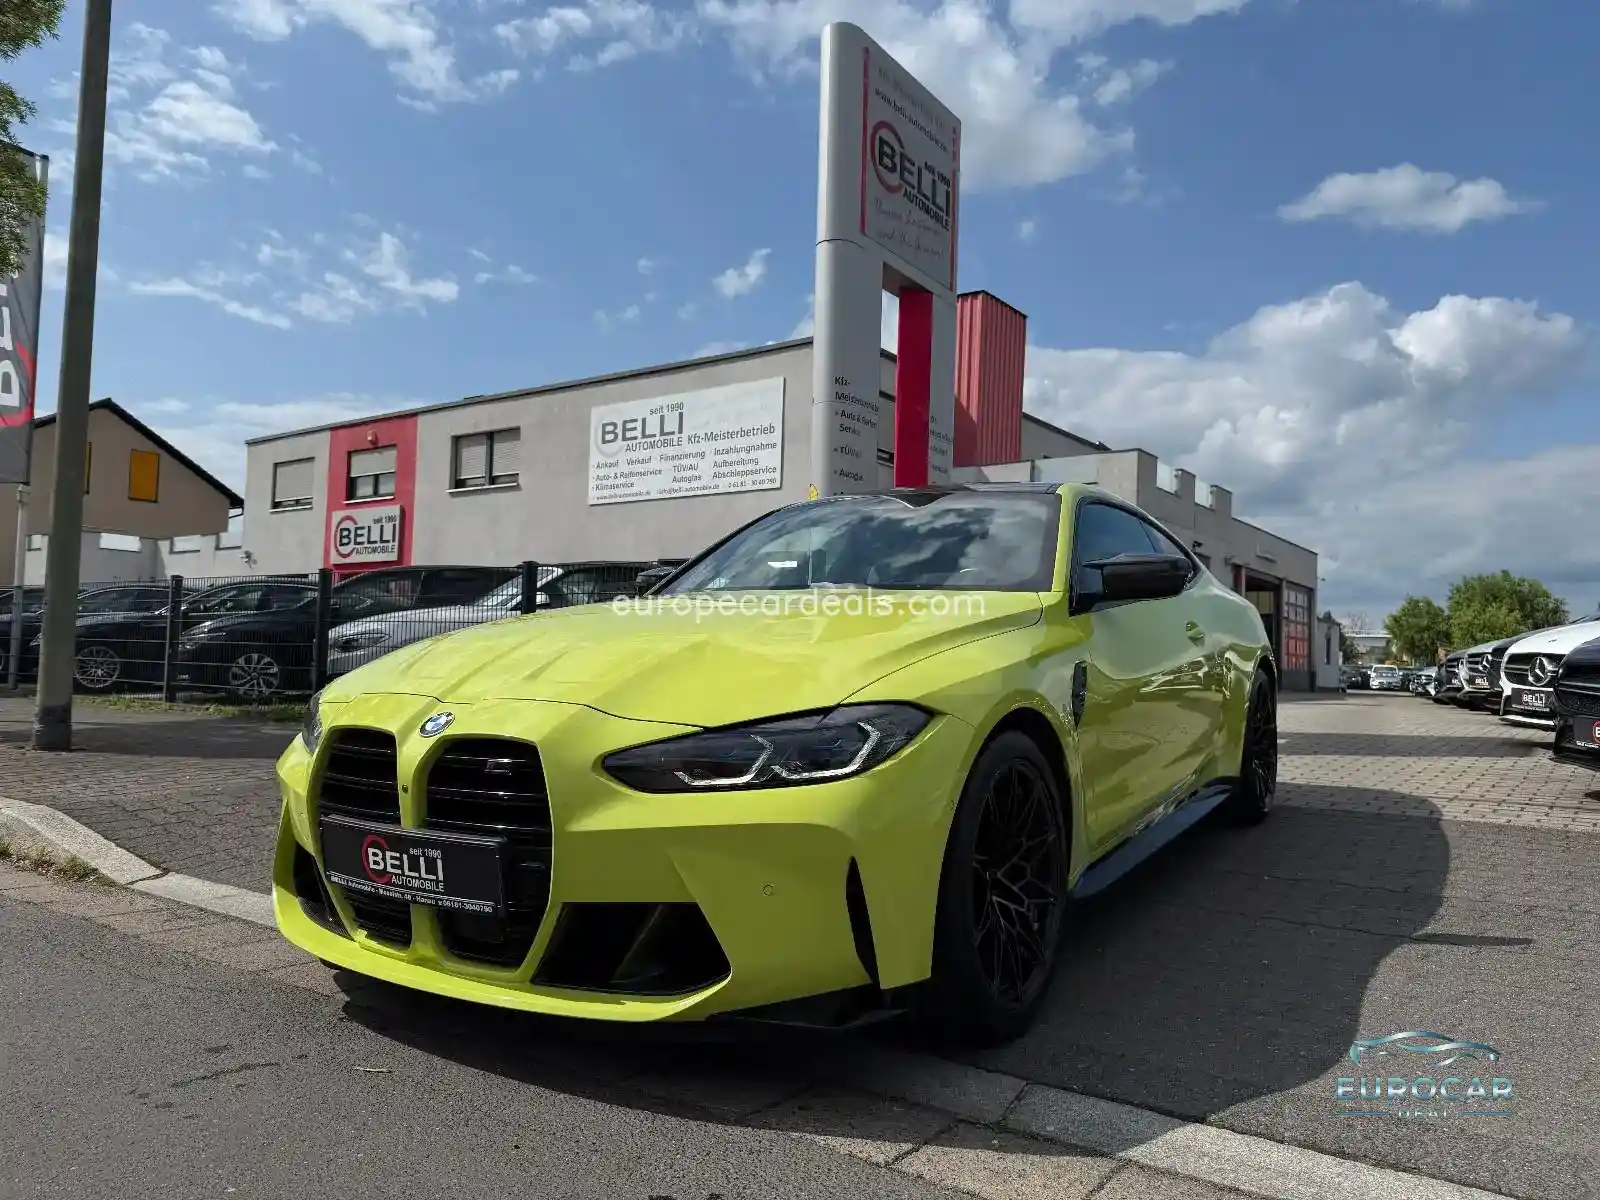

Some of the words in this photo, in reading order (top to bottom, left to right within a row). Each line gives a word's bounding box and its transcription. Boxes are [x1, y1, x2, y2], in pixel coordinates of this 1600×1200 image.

[878, 134, 951, 218] BELLI
[902, 186, 950, 232] AUTOMOBILE
[834, 376, 851, 387] Kfz-
[649, 404, 665, 416] seit
[666, 401, 684, 413] 1990
[601, 411, 684, 444] BELLI
[687, 423, 776, 445] Kfz-Meisterbetrieb
[625, 436, 683, 453] AUTOMOBILE
[714, 442, 777, 456] Inzahlungnahme
[626, 456, 652, 466] Verkauf
[660, 450, 706, 463] Finanzierung
[712, 457, 759, 470] Aufbereitung
[596, 460, 619, 470] Ankauf
[619, 468, 663, 480] Reifenservice
[671, 474, 702, 485] Autoglas
[712, 465, 777, 480] Abschleppservice
[339, 523, 397, 547] BELLI
[355, 544, 396, 556] AUTOMOBILE
[409, 846, 423, 857] seit
[424, 848, 442, 859] 1990
[367, 847, 444, 881] BELLI
[391, 874, 445, 892] AUTOMOBILE
[416, 896, 436, 905] Hanau
